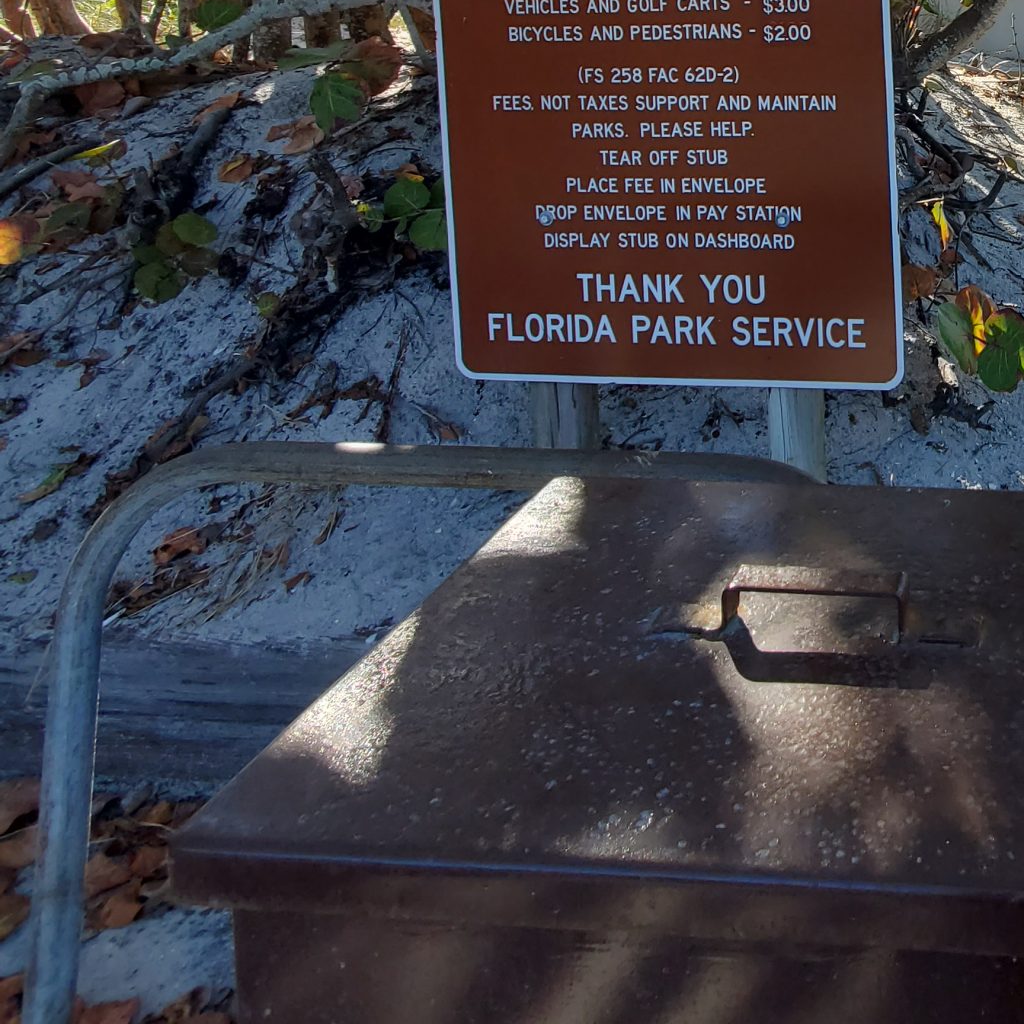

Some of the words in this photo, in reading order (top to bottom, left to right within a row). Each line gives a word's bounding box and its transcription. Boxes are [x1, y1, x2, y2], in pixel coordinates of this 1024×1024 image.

[505, 0, 579, 14] VEHICLES
[509, 26, 582, 41] BICYCLES
[591, 26, 623, 40] AND
[631, 24, 741, 40] PEDESTRIANS
[764, 25, 810, 42] $2.00
[579, 67, 603, 83] (FS
[611, 68, 642, 83] 258
[649, 68, 678, 82] FAC
[685, 67, 738, 83] 62D-2)
[541, 96, 570, 110] NOT
[578, 96, 628, 110] TAXES
[636, 96, 708, 111] SUPPORT
[717, 96, 750, 110] AND
[759, 96, 836, 110] MAINTAIN
[573, 123, 628, 137] PARKS.
[641, 122, 703, 137] PLEASE
[711, 122, 754, 136] HELP.
[600, 151, 641, 165] TEAR
[650, 151, 679, 165] OFF
[687, 150, 727, 164] STUB
[567, 178, 618, 192] PLACE
[625, 178, 654, 193] FEE
[661, 179, 675, 192] IN
[682, 178, 766, 193] ENVELOPE
[536, 205, 577, 220] DROP
[584, 206, 666, 220] ENVELOPE
[677, 206, 690, 220] IN
[697, 206, 727, 220] PAY
[737, 206, 801, 221] STATION
[545, 233, 609, 247] DISPLAY
[619, 233, 658, 247] STUB
[666, 233, 688, 248] ON
[695, 233, 794, 249] DASHBOARD
[577, 274, 684, 302] THANK
[700, 275, 765, 304] YOU
[488, 314, 616, 342] FLORIDA
[632, 316, 716, 344] PARK
[733, 317, 865, 348] SERVICE
